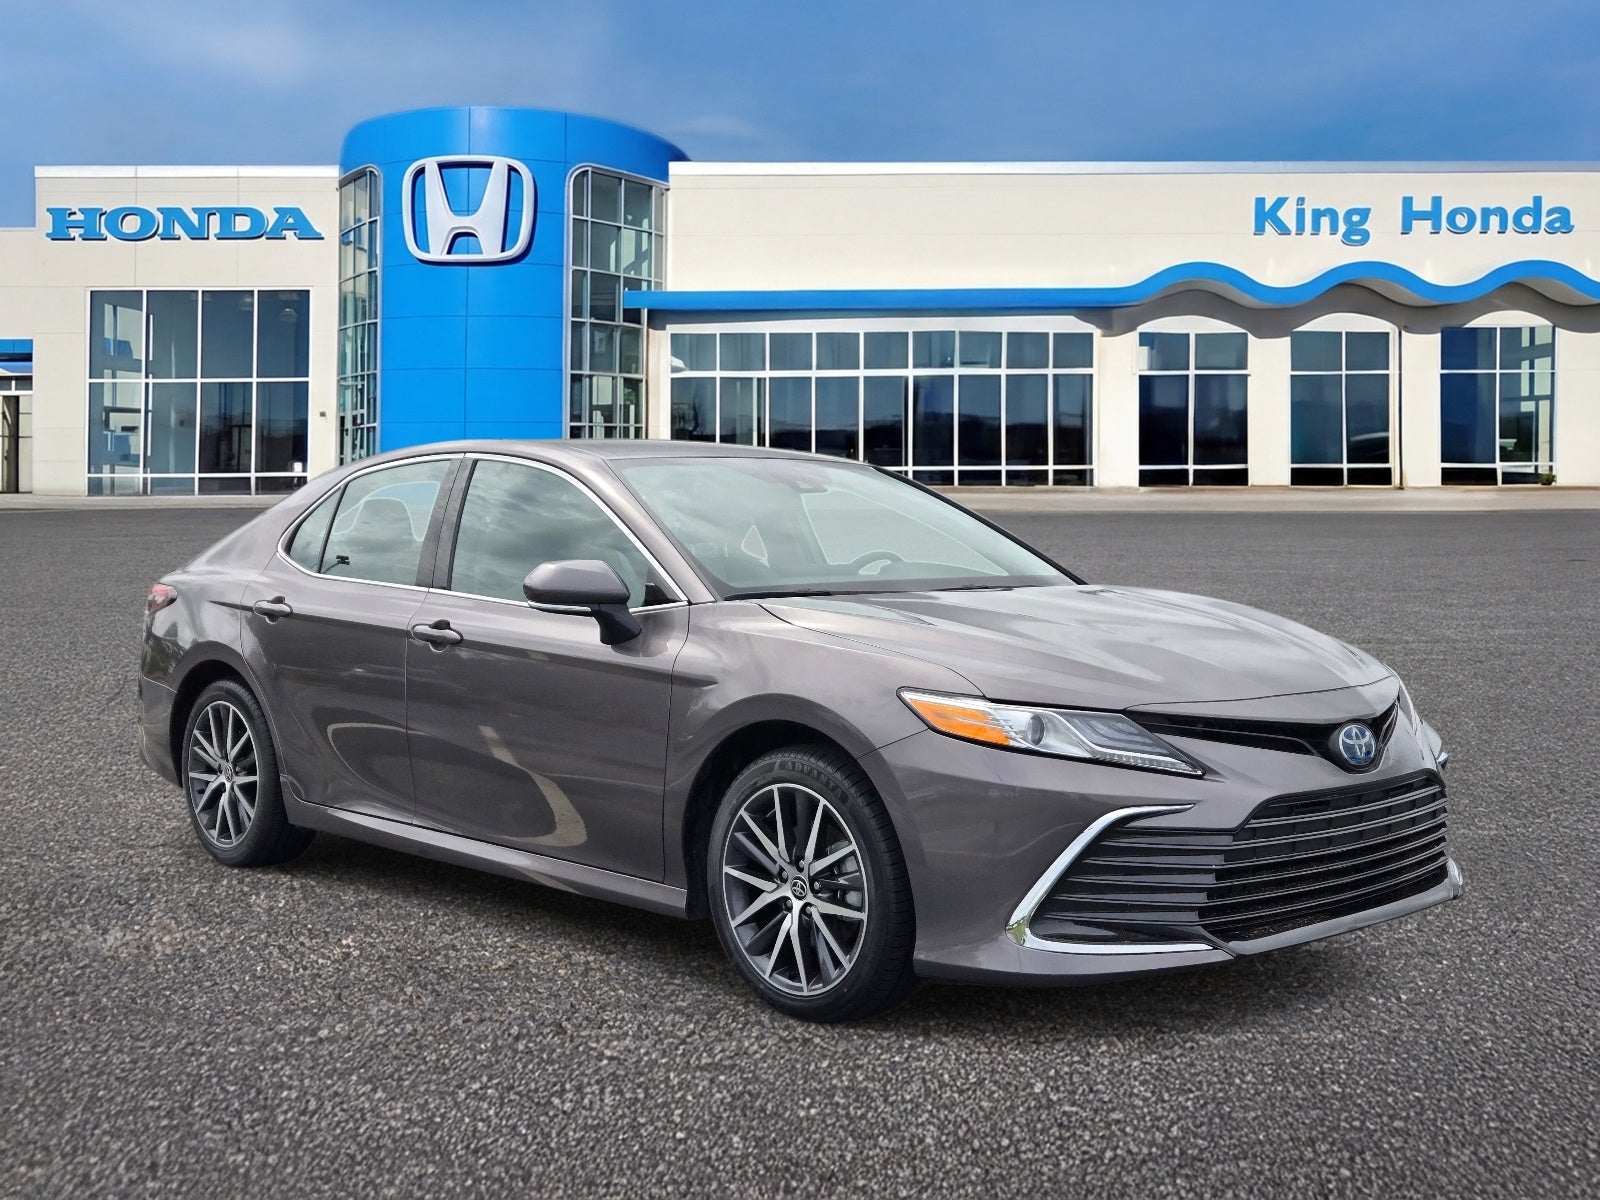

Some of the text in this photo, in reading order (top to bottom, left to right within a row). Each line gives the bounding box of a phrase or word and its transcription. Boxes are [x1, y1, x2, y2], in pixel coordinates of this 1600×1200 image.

[46, 206, 324, 242] HONDA
[1254, 195, 1574, 246] King Honda
